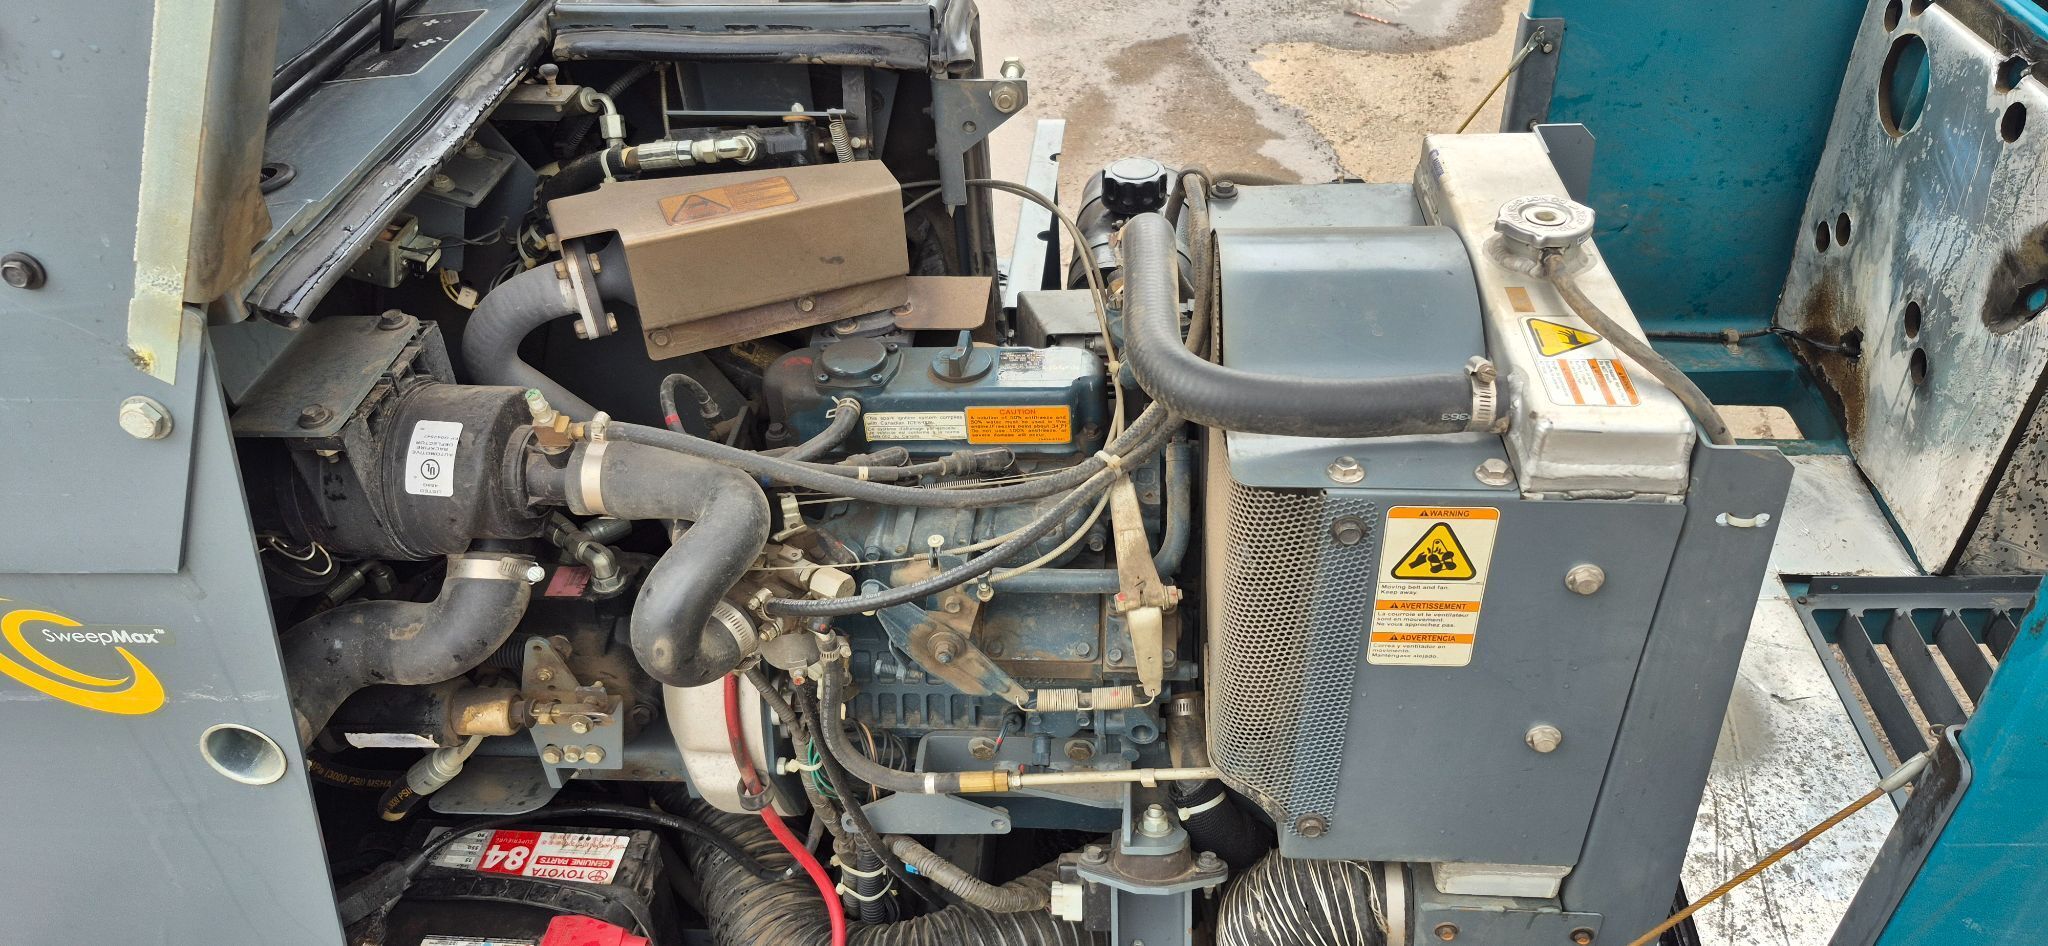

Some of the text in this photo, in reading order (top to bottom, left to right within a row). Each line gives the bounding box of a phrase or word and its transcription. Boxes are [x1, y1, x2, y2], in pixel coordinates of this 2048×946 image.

[1400, 602, 1467, 610] AVERTISSEMENT
[482, 844, 530, 871] 84
[539, 856, 610, 868] GENUINE PARTS
[532, 867, 584, 880] TOYOTA
